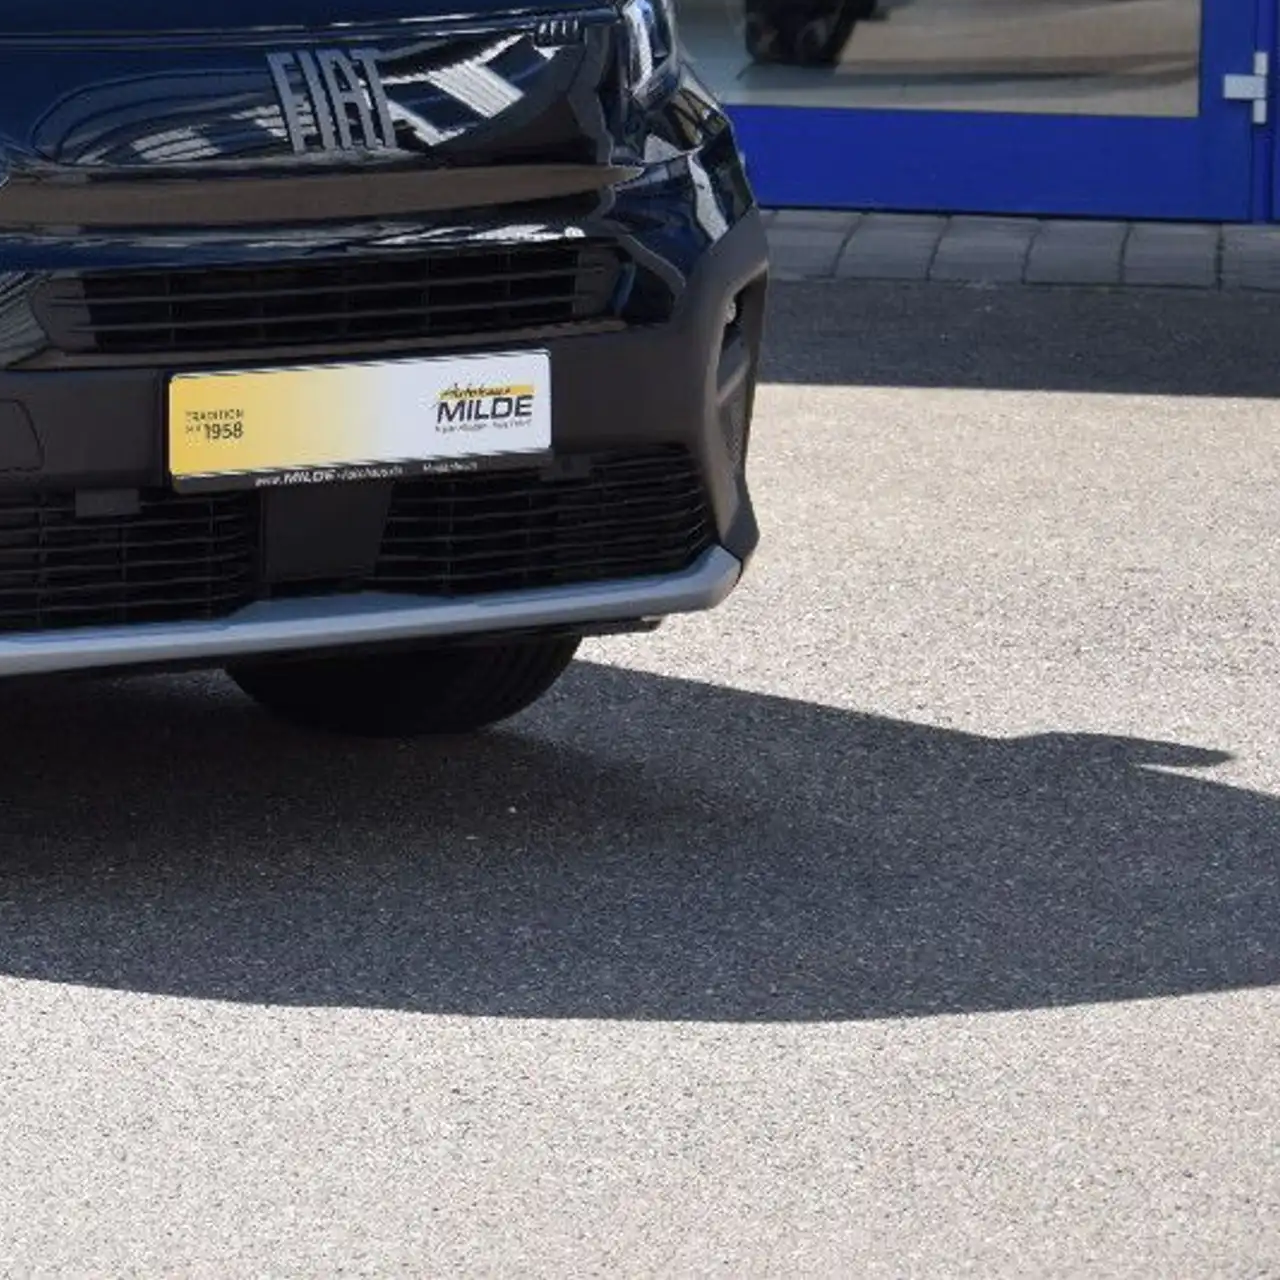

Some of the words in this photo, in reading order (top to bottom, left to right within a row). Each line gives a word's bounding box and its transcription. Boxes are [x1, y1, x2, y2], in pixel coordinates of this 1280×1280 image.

[265, 48, 398, 154] FIAT
[437, 395, 533, 424] MILDE
[204, 420, 244, 440] 1958
